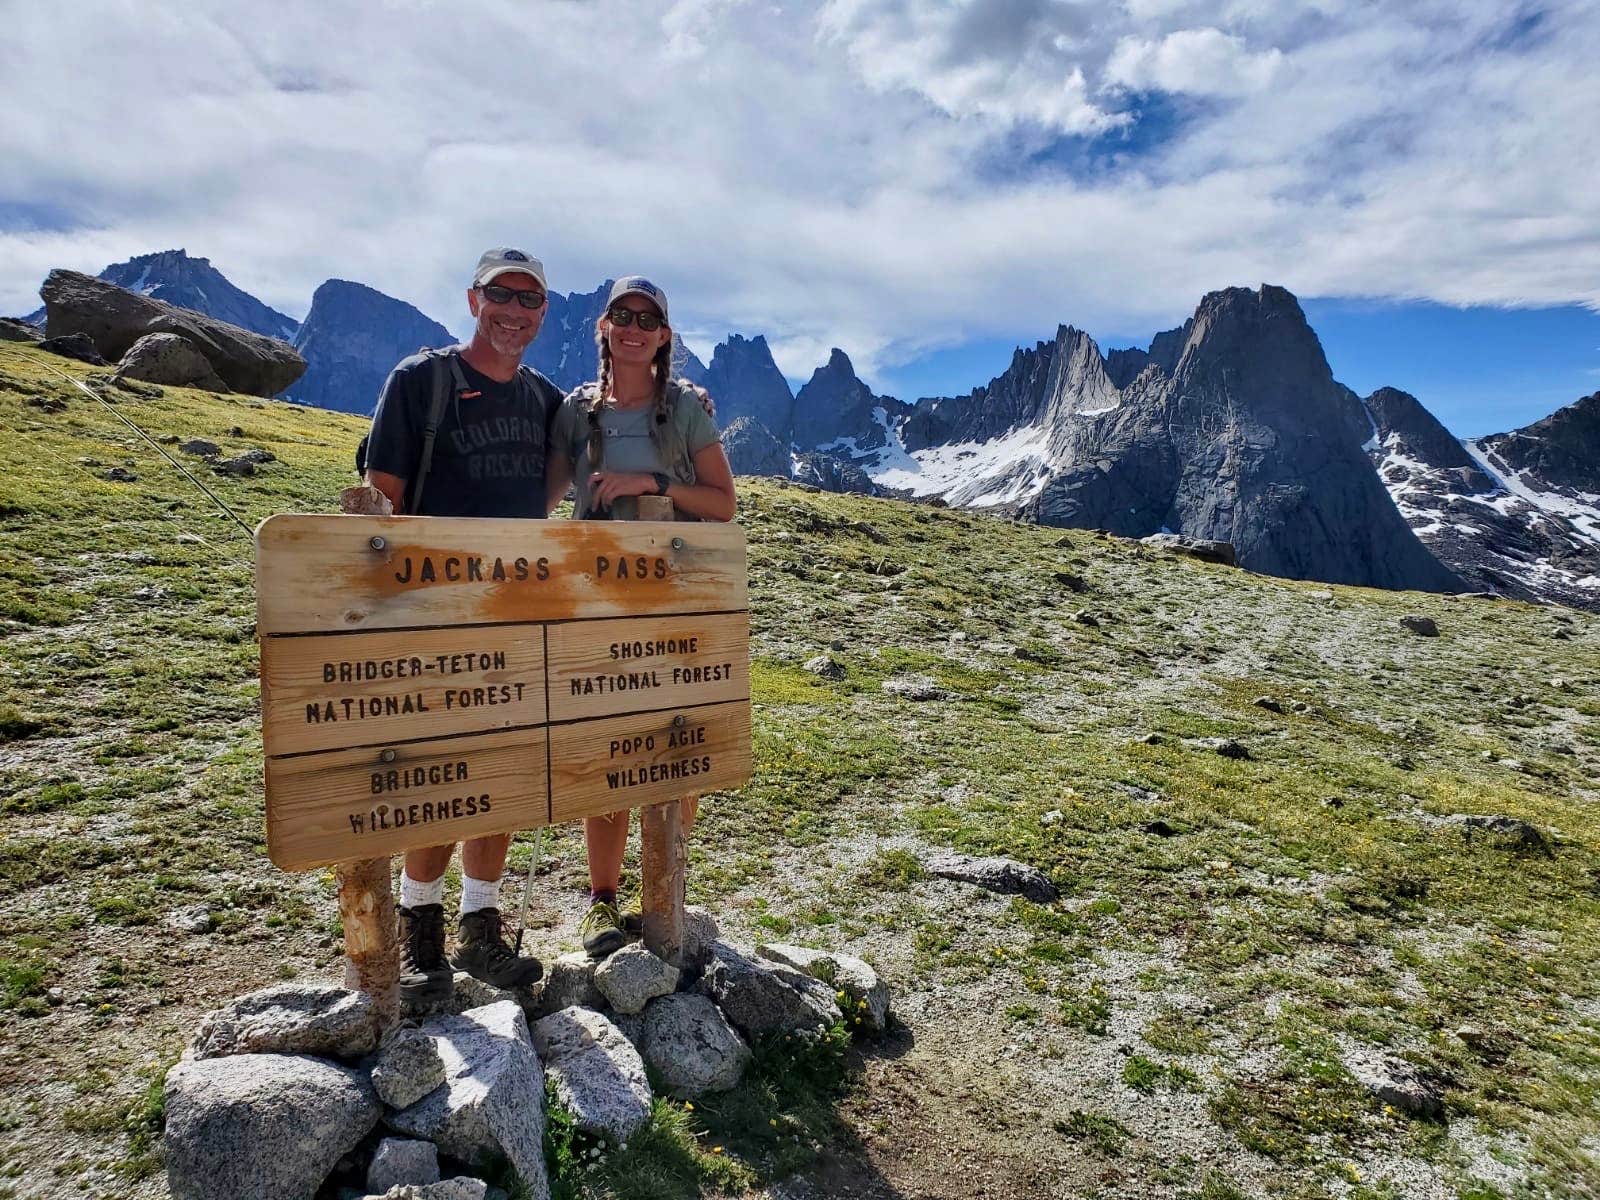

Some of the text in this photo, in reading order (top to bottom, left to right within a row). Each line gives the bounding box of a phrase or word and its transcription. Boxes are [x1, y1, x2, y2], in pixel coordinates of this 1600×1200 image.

[450, 416, 545, 455] COLORAD
[394, 555, 667, 584] JACKASS PASS
[609, 637, 698, 660] SHOSHONE
[323, 650, 506, 683] BRIDGER-TETON
[570, 663, 732, 696] NATIONAL FOREST
[306, 682, 526, 724] NATIONAL FOREST
[609, 727, 706, 760] POPO AGIE
[370, 761, 469, 794] BRIDGER
[605, 755, 711, 790] WILDERNESS
[349, 793, 492, 834] WILDERNESS
